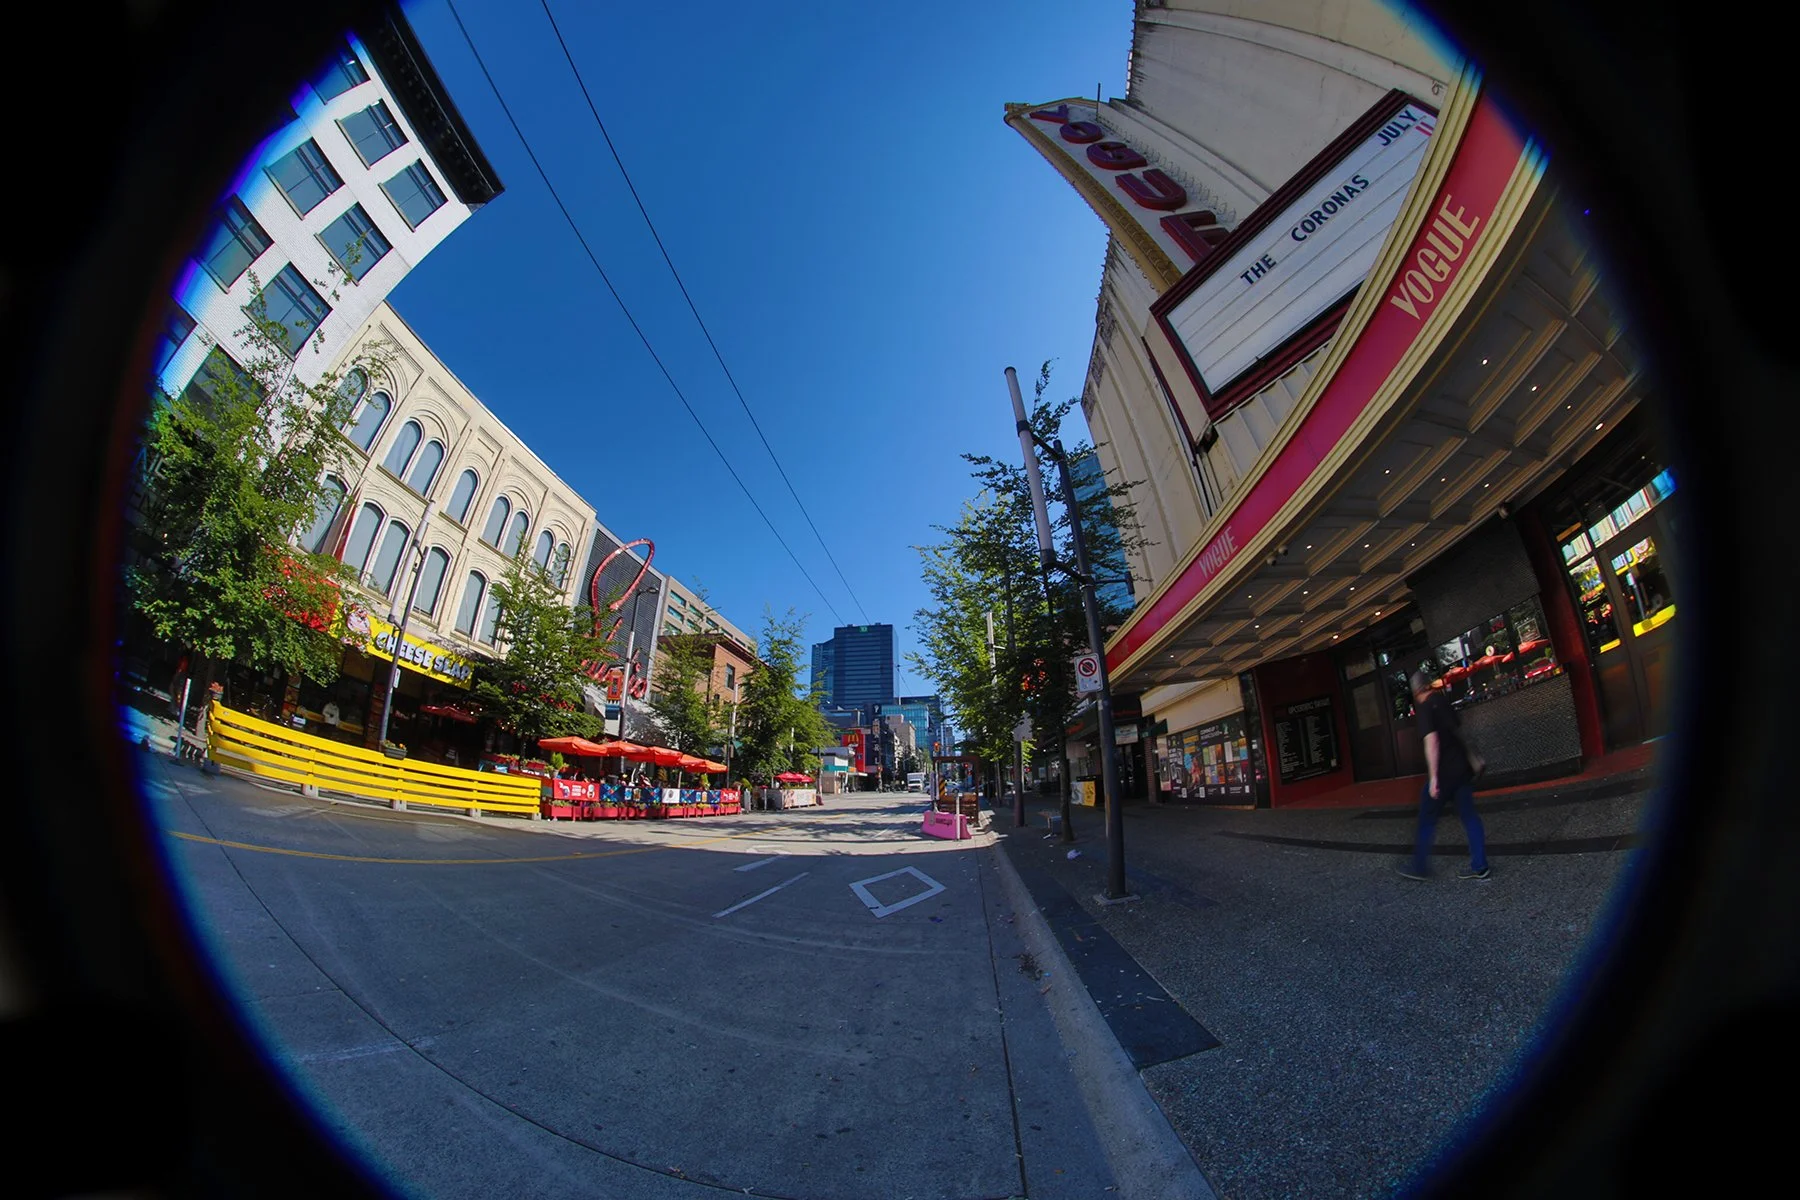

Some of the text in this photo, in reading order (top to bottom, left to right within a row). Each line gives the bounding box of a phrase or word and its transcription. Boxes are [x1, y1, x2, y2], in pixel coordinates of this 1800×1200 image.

[1377, 110, 1417, 147] JULY
[1029, 104, 1231, 263] VOGUE
[1240, 174, 1371, 286] THE CORONAS
[1390, 194, 1481, 320] VOGUE
[1198, 527, 1240, 581] VOGUE
[375, 631, 472, 682] CHEESE SLAP
